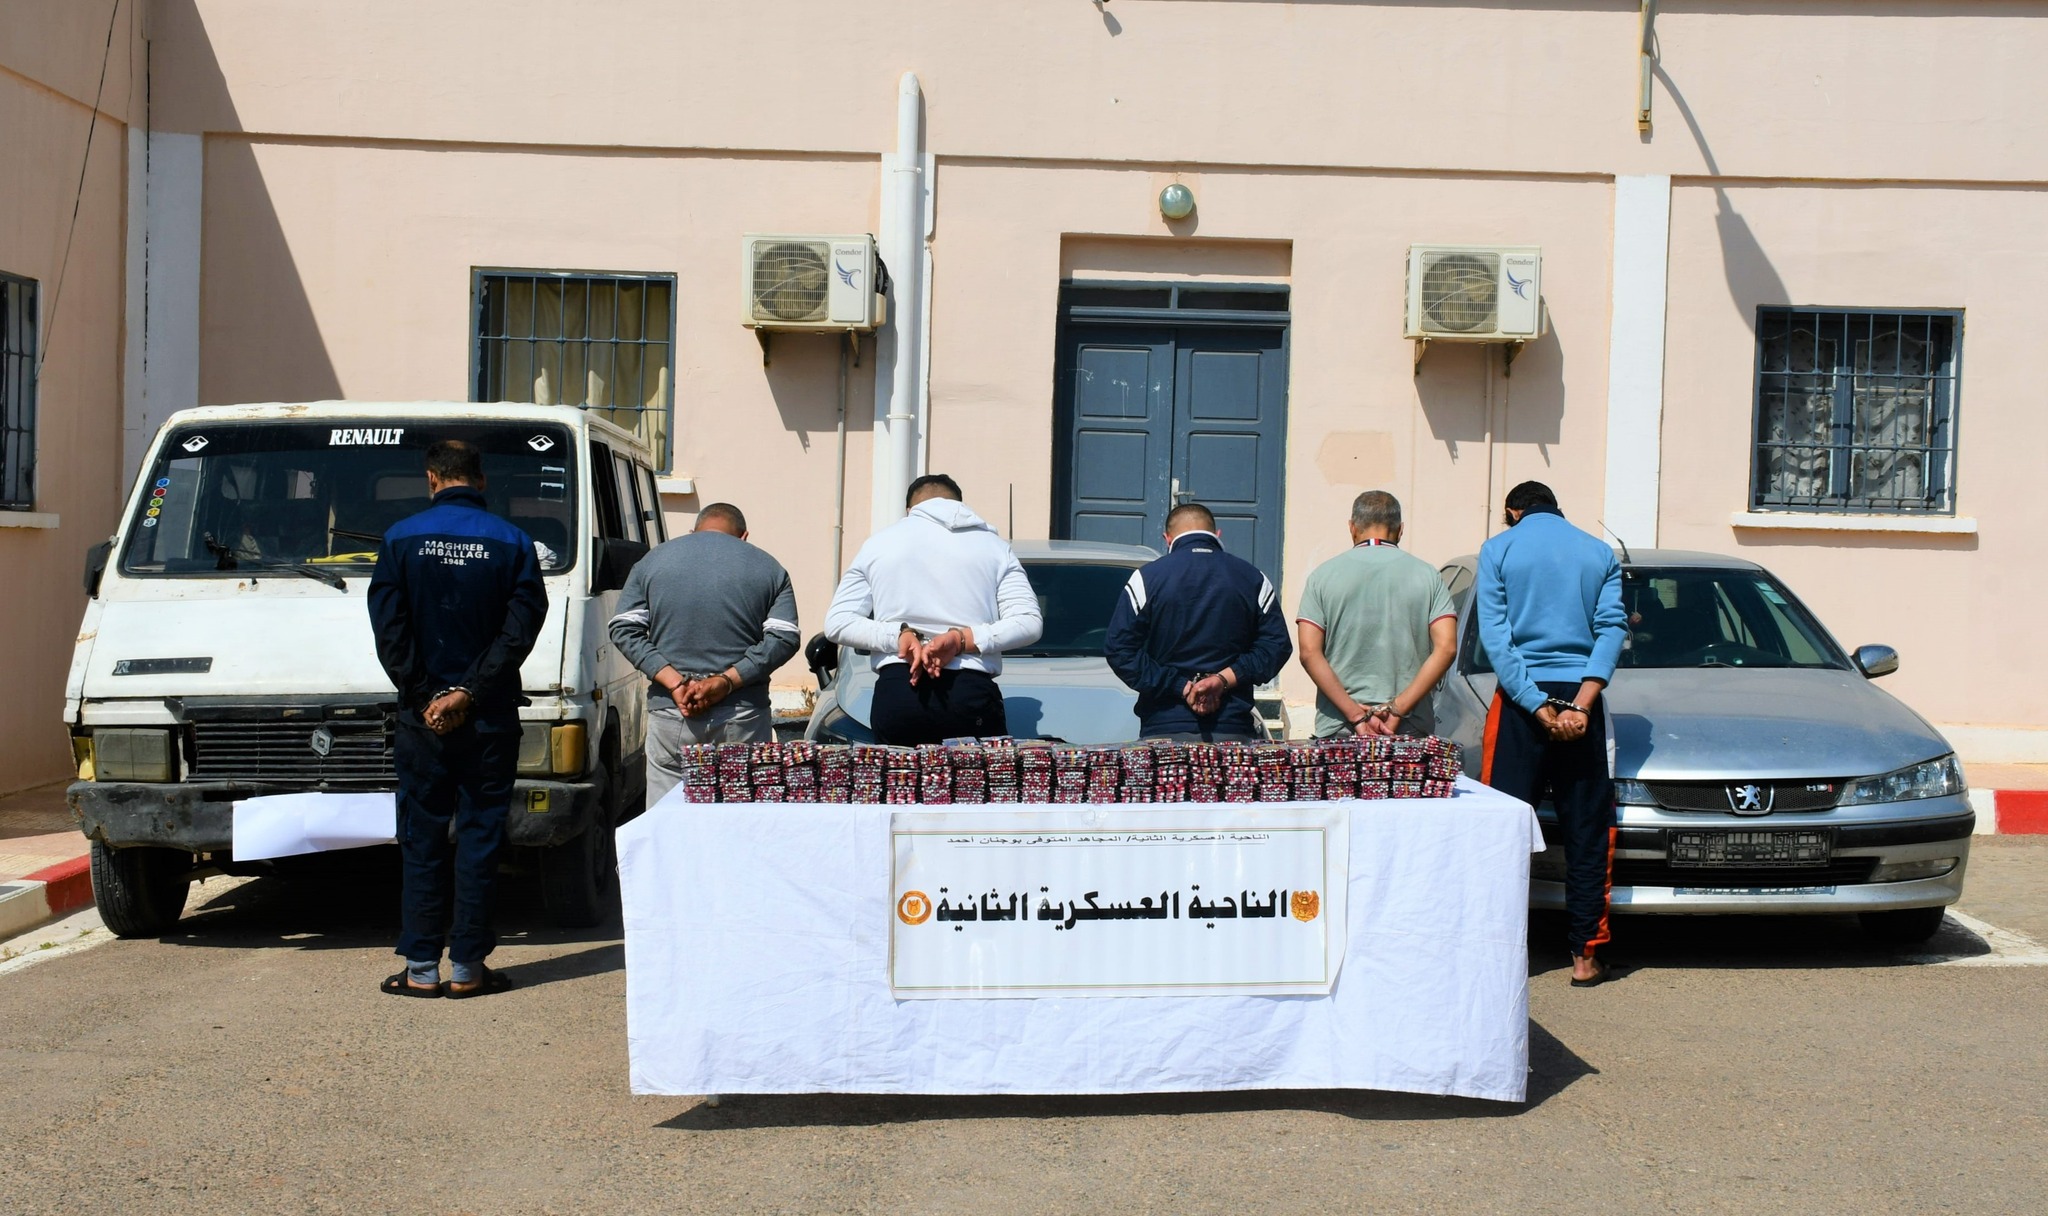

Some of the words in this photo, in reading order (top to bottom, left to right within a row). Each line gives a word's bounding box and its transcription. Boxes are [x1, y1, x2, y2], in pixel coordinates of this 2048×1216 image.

[834, 248, 863, 256] Condor
[1506, 258, 1535, 266] Condor
[328, 428, 405, 446] RENAULT
[424, 540, 485, 552] MAGHREB
[418, 547, 491, 560] EMBALLAGE
[531, 790, 547, 810] P
[1077, 835, 1122, 844] المجاهد
[1171, 834, 1225, 844] العسكرية
[1230, 833, 1270, 842] الناحية
[936, 887, 1028, 932] الثانية
[1038, 886, 1180, 931] العسكرية
[1188, 884, 1288, 929] الناحية
